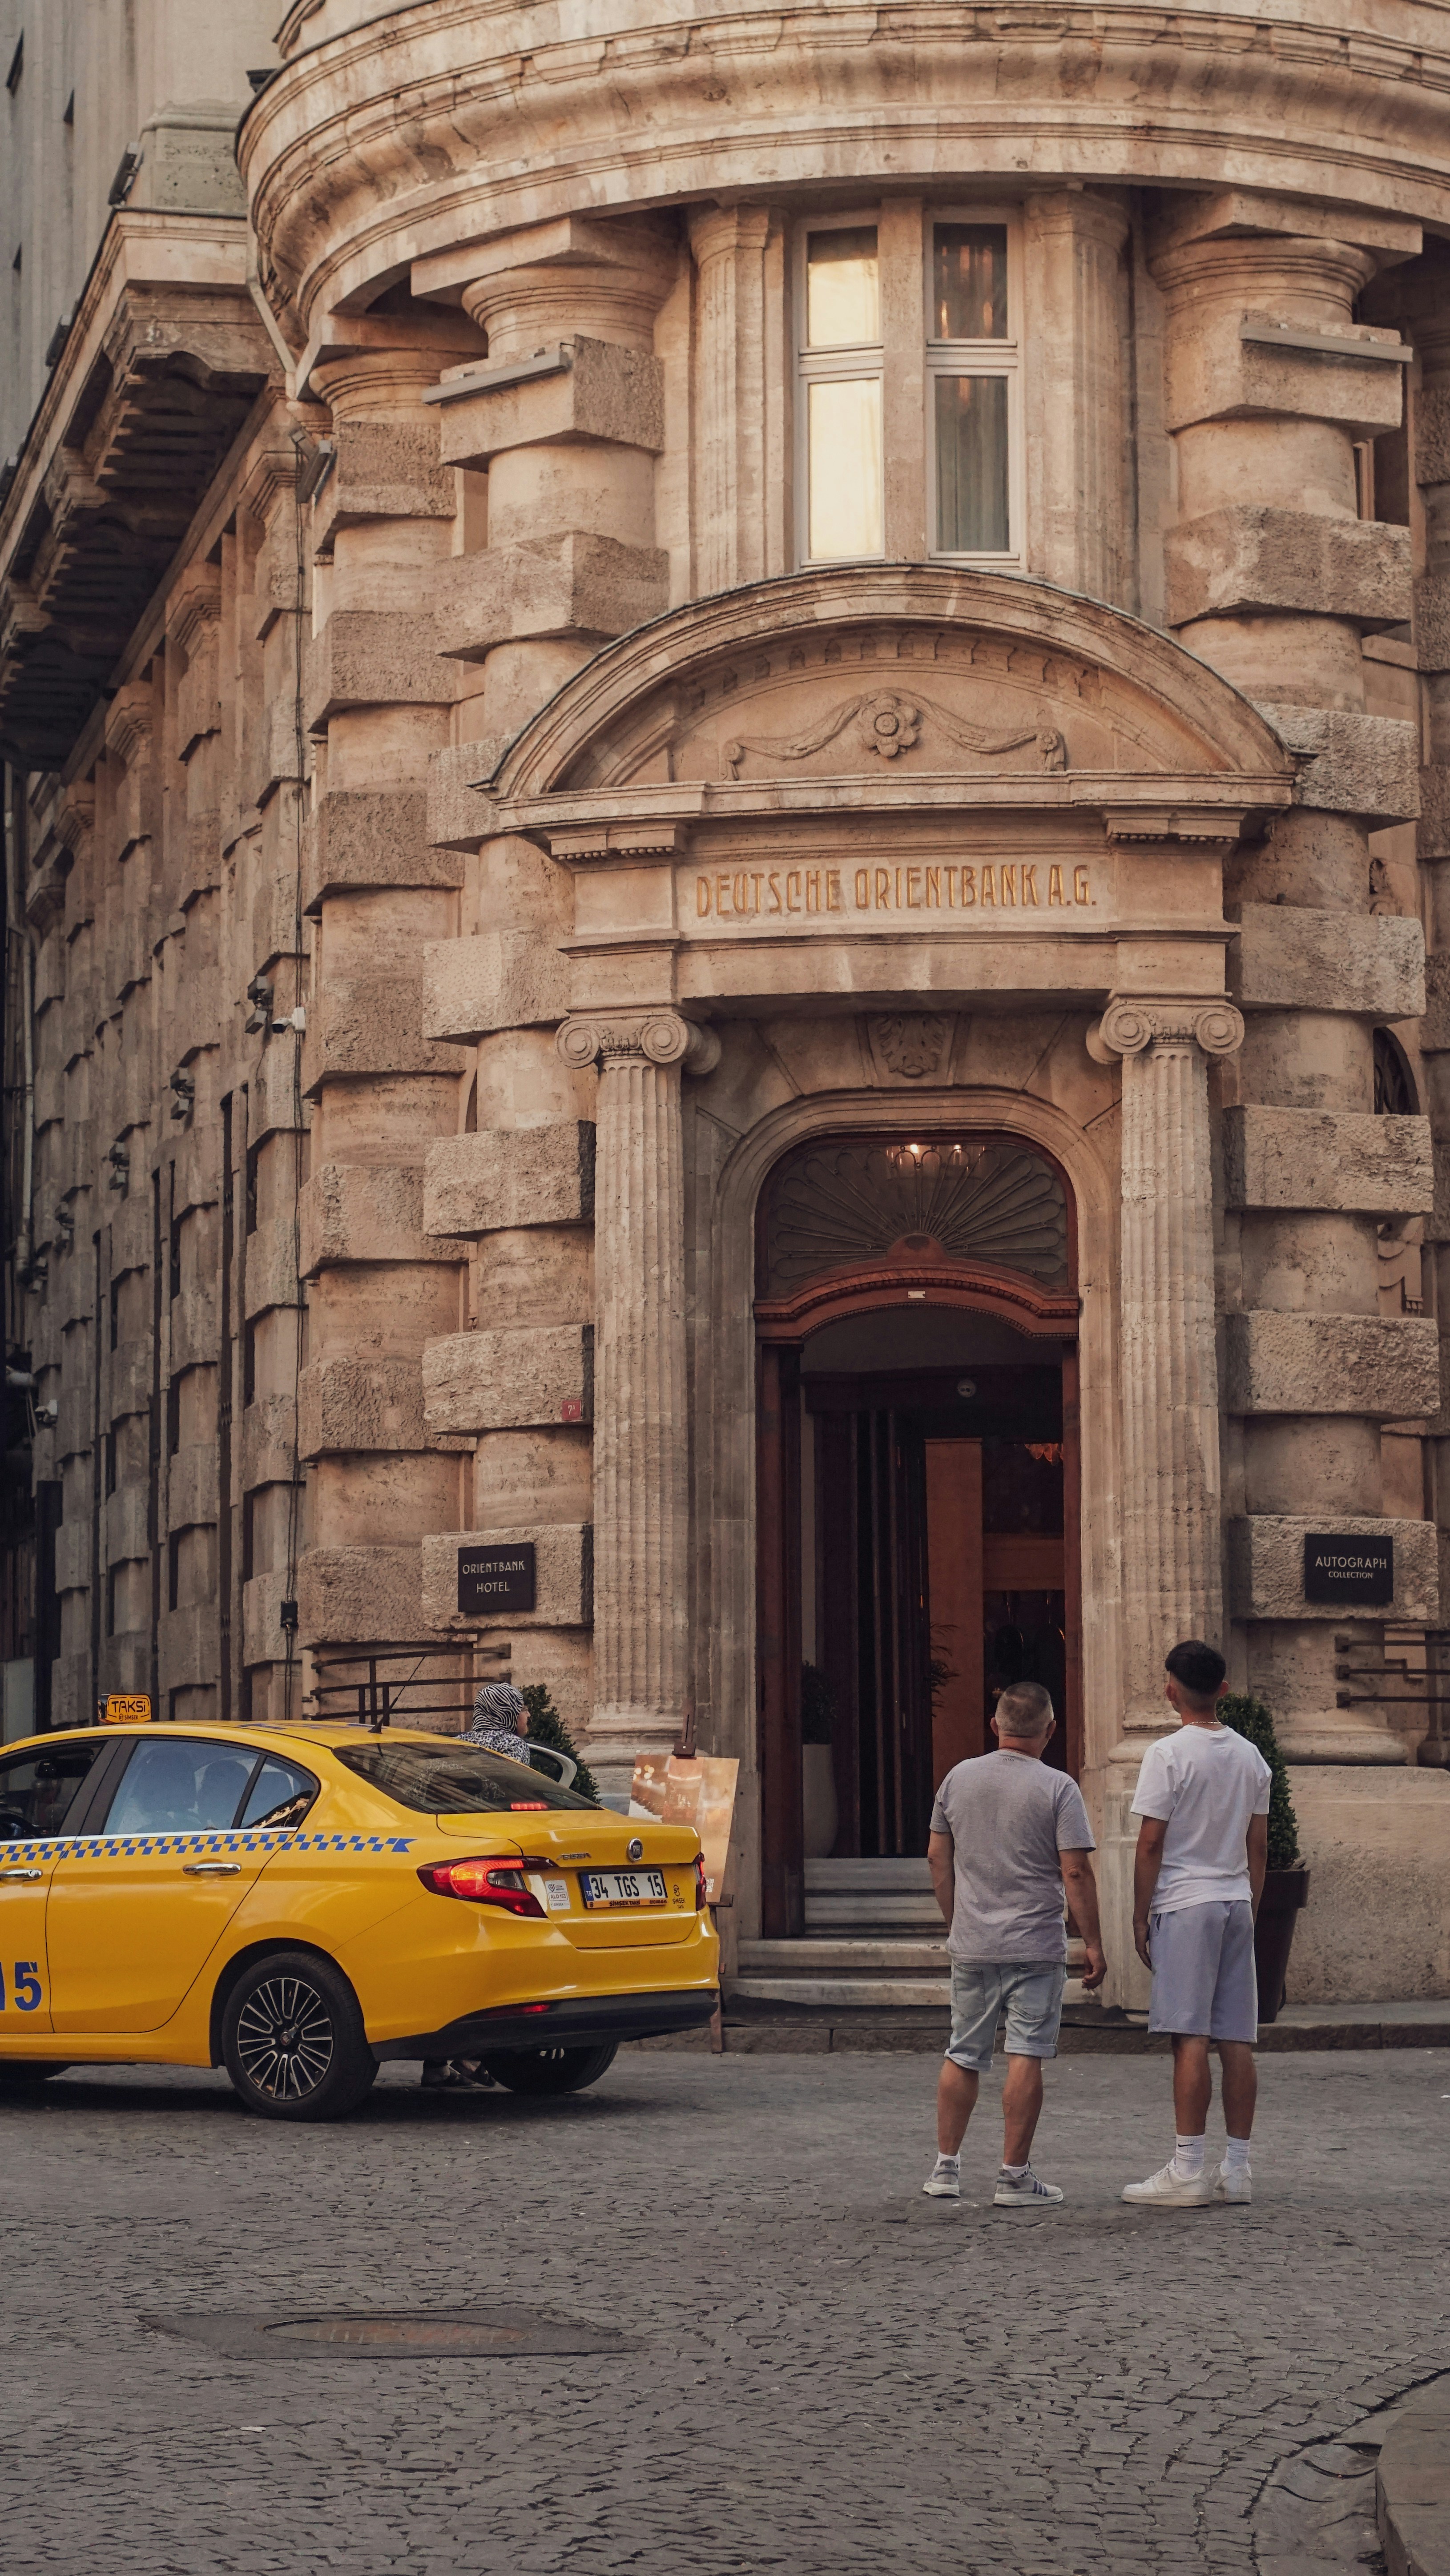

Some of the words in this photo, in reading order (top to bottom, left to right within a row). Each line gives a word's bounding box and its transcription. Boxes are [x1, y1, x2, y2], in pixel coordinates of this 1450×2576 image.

[697, 869, 840, 917] DEUTSCHE
[855, 864, 1039, 910] ORIENTBANK
[1048, 864, 1097, 906] A.G.
[462, 1560, 525, 1575] ORIENTBANK
[1315, 1556, 1387, 1569] AUTOGRAPH
[1328, 1571, 1373, 1579] COLLECTION
[476, 1581, 511, 1593] HOTEL
[591, 1877, 609, 1899] 34
[614, 1875, 640, 1897] TGS
[647, 1875, 663, 1896] 15
